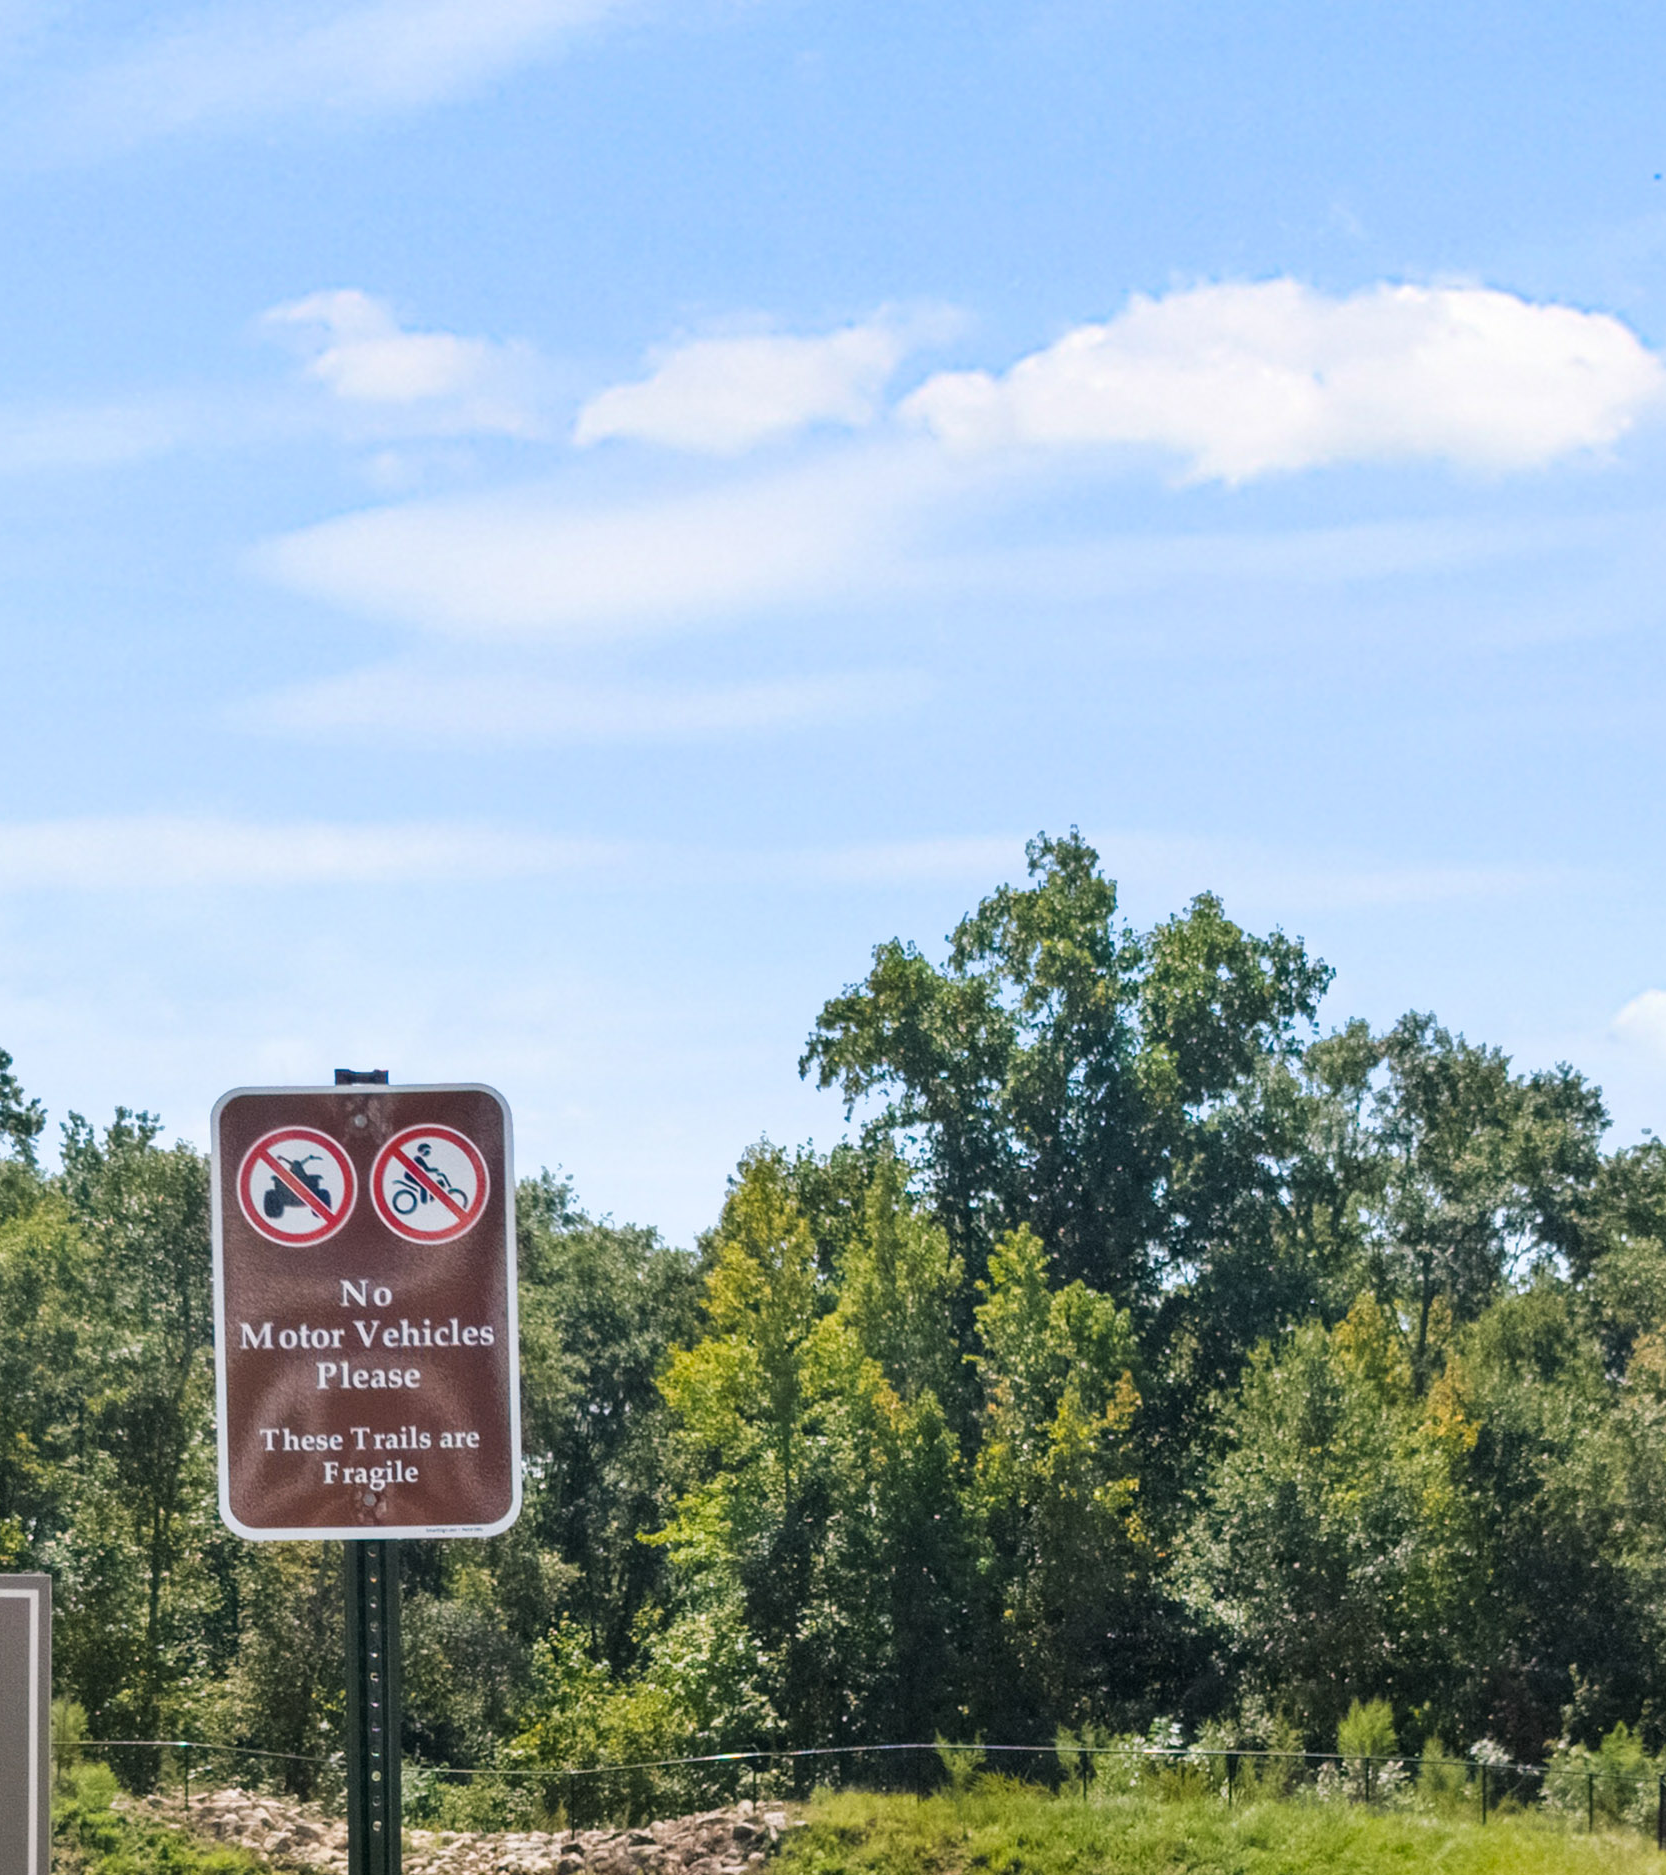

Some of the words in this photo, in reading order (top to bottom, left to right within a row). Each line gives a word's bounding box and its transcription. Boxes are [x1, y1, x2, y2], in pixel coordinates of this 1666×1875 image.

[339, 1279, 393, 1307] No
[239, 1321, 345, 1350] Motor
[352, 1318, 495, 1348] Vehicles
[316, 1361, 421, 1391] Please
[260, 1428, 343, 1452] These
[350, 1425, 432, 1451] Trails
[439, 1430, 481, 1449] are
[323, 1461, 419, 1491] Fragile
